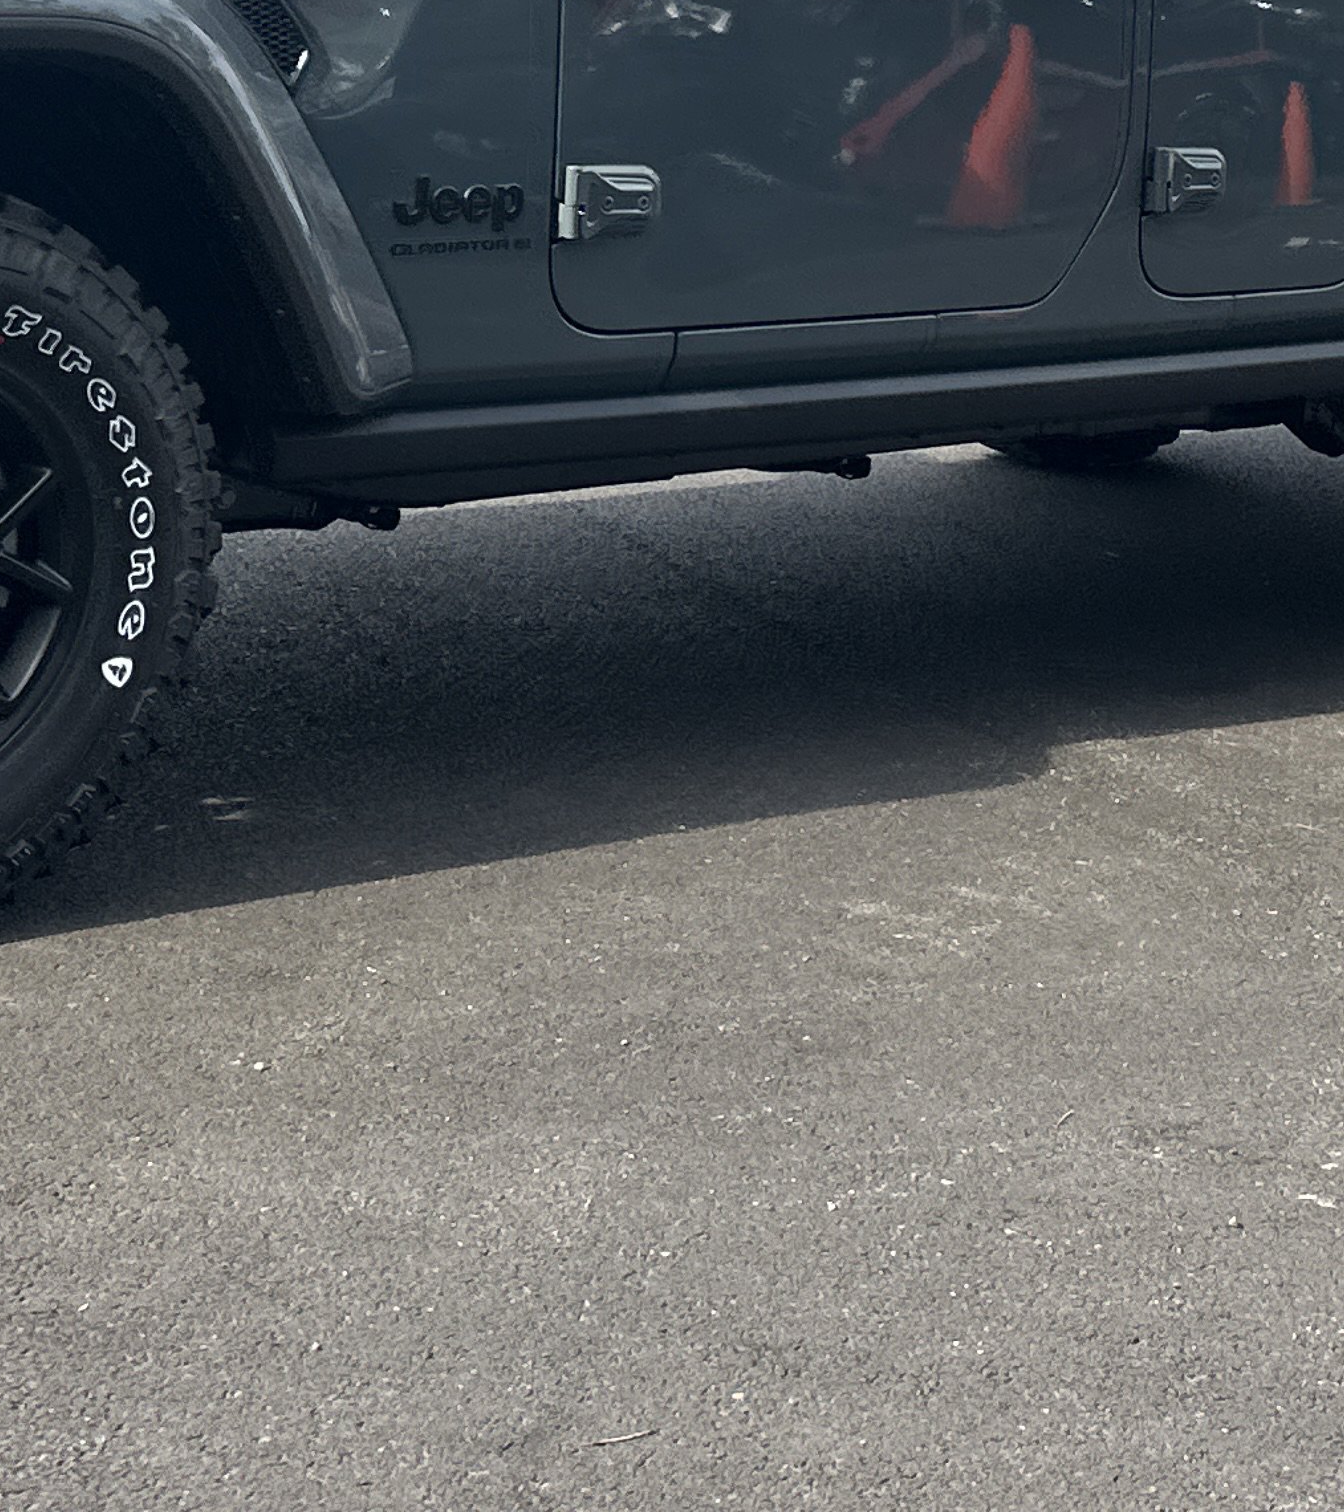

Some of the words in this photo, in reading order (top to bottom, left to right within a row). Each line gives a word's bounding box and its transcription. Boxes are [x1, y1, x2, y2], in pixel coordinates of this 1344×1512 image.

[393, 175, 525, 232] Jeep
[389, 239, 510, 257] GLADIATOR
[2, 304, 156, 640] Firestone
